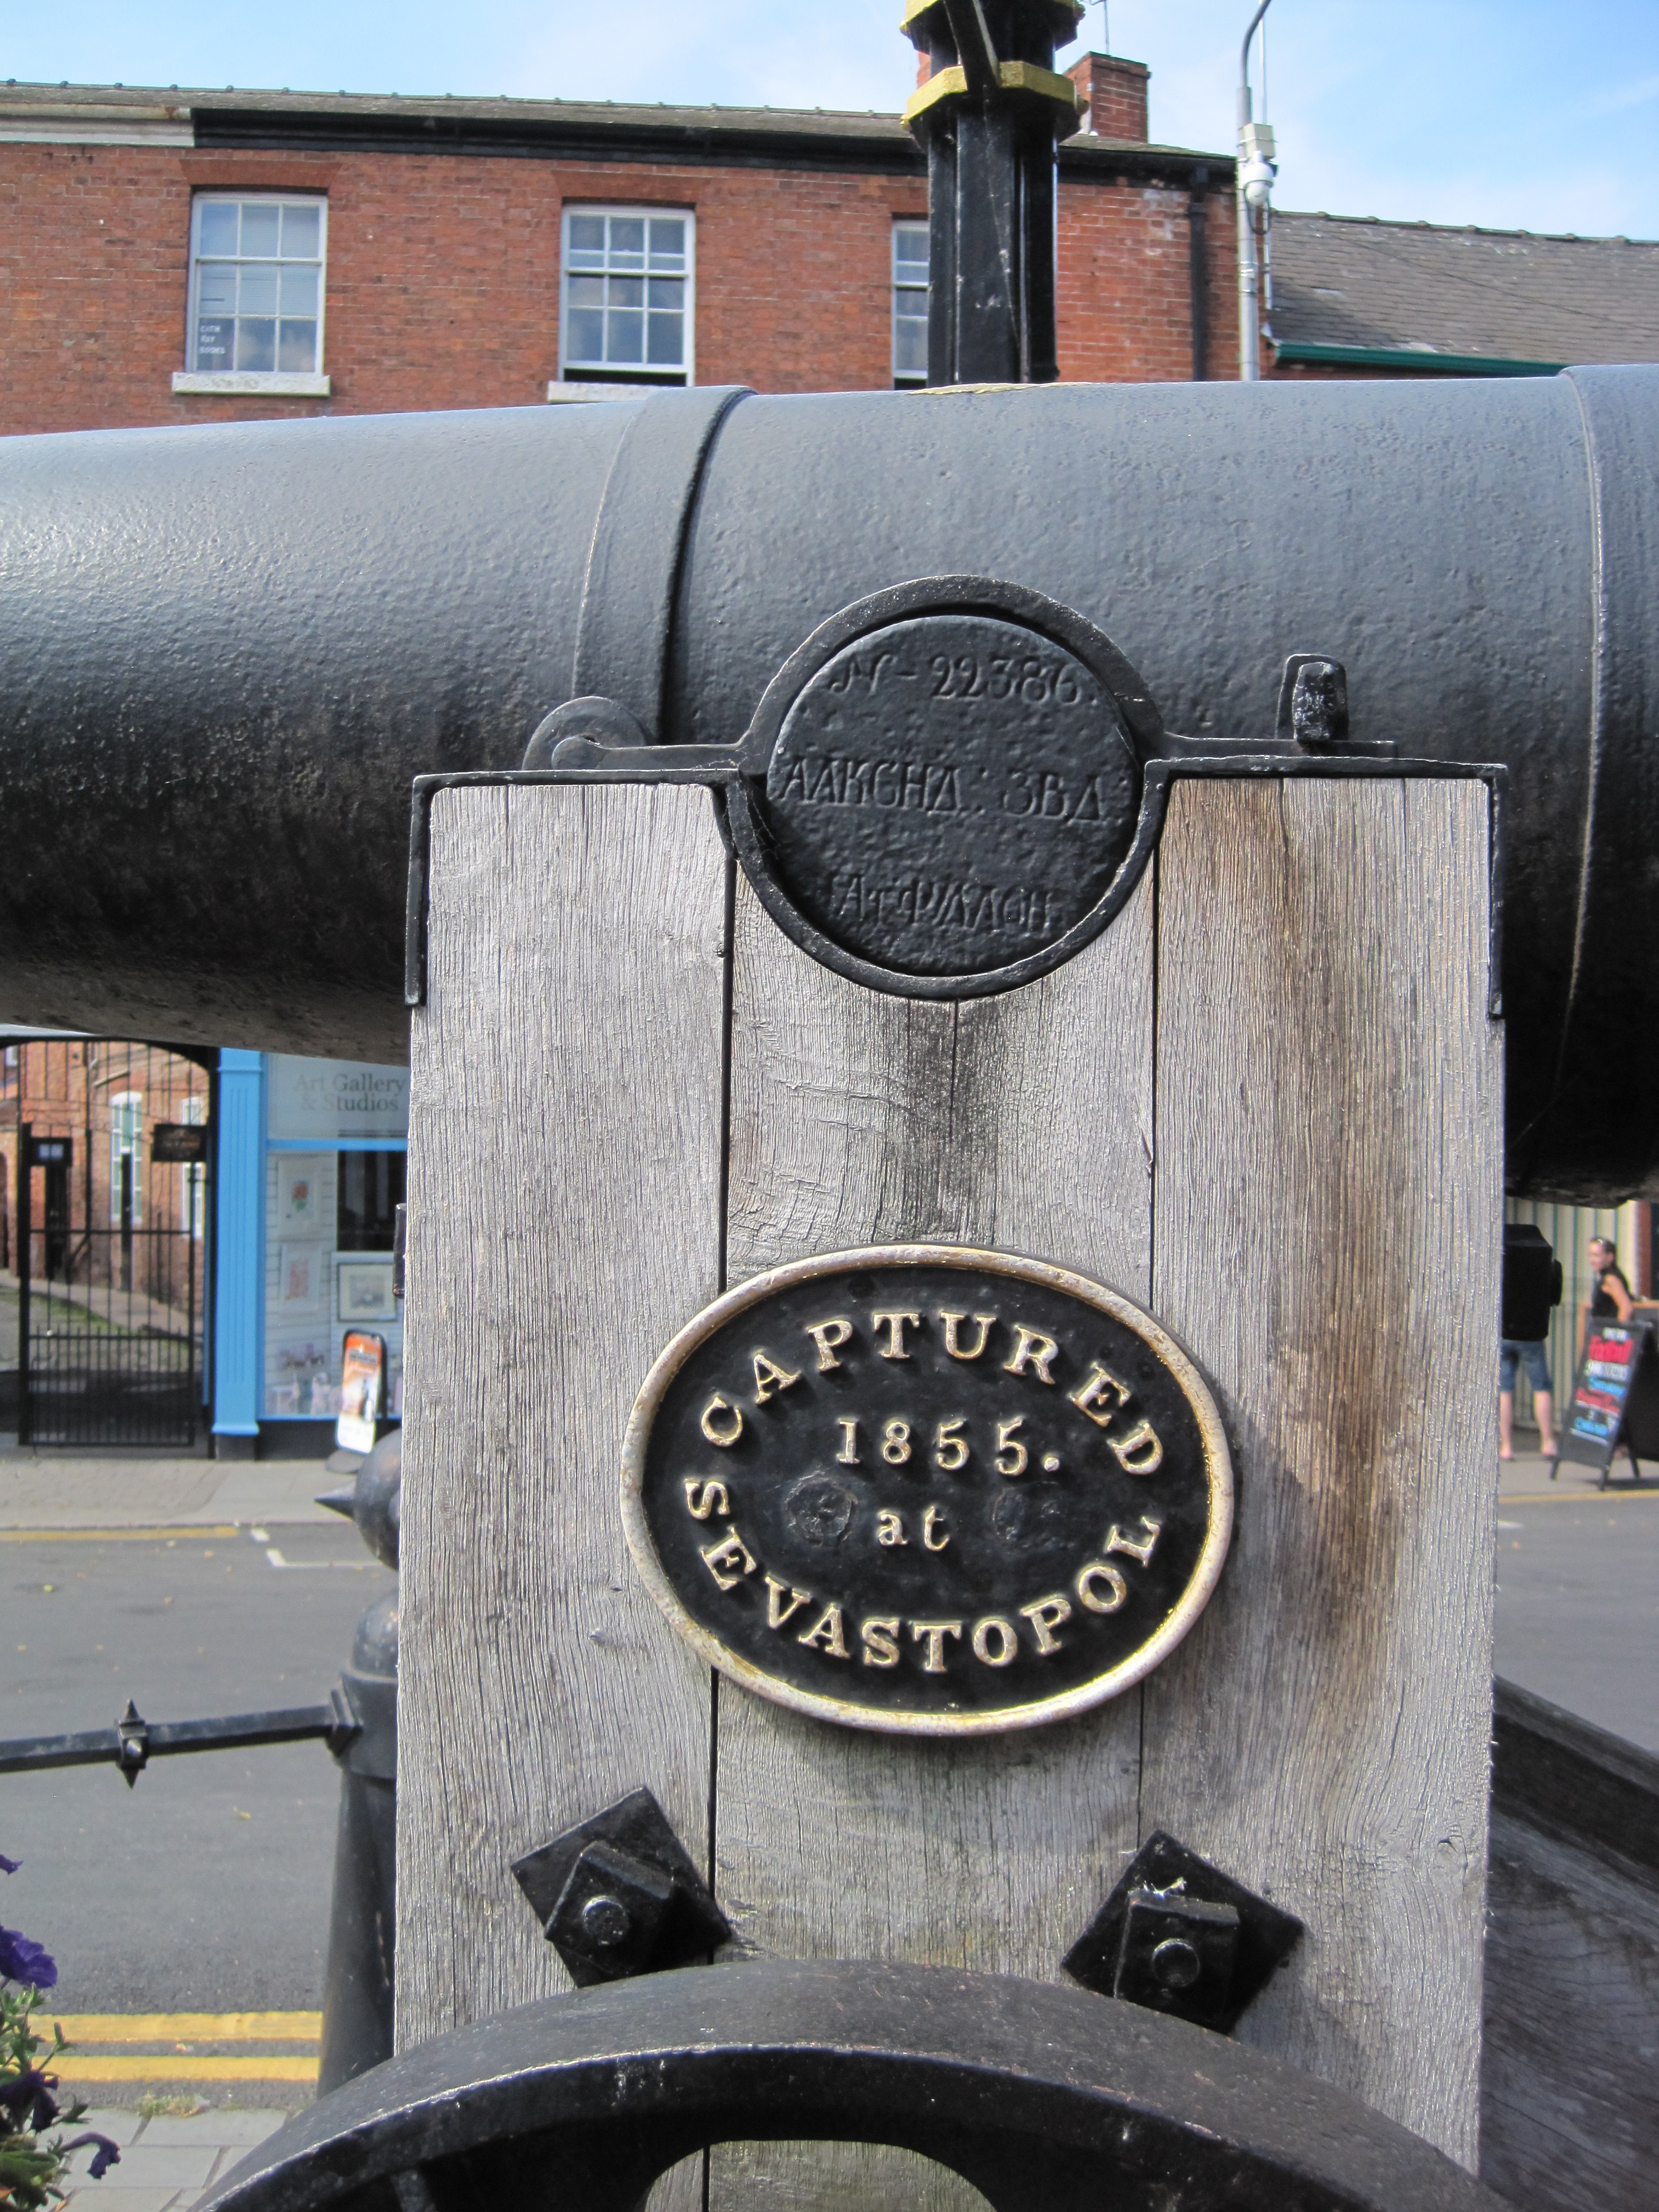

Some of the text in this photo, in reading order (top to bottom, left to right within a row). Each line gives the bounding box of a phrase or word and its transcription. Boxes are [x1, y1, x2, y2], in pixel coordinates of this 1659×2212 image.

[323, 1090, 399, 1111] Studios
[332, 1073, 407, 1097] Gallery
[701, 1311, 1165, 1476] CAPTURED
[877, 1505, 951, 1552] at
[685, 1476, 1162, 1674] SEVASTOPOL
